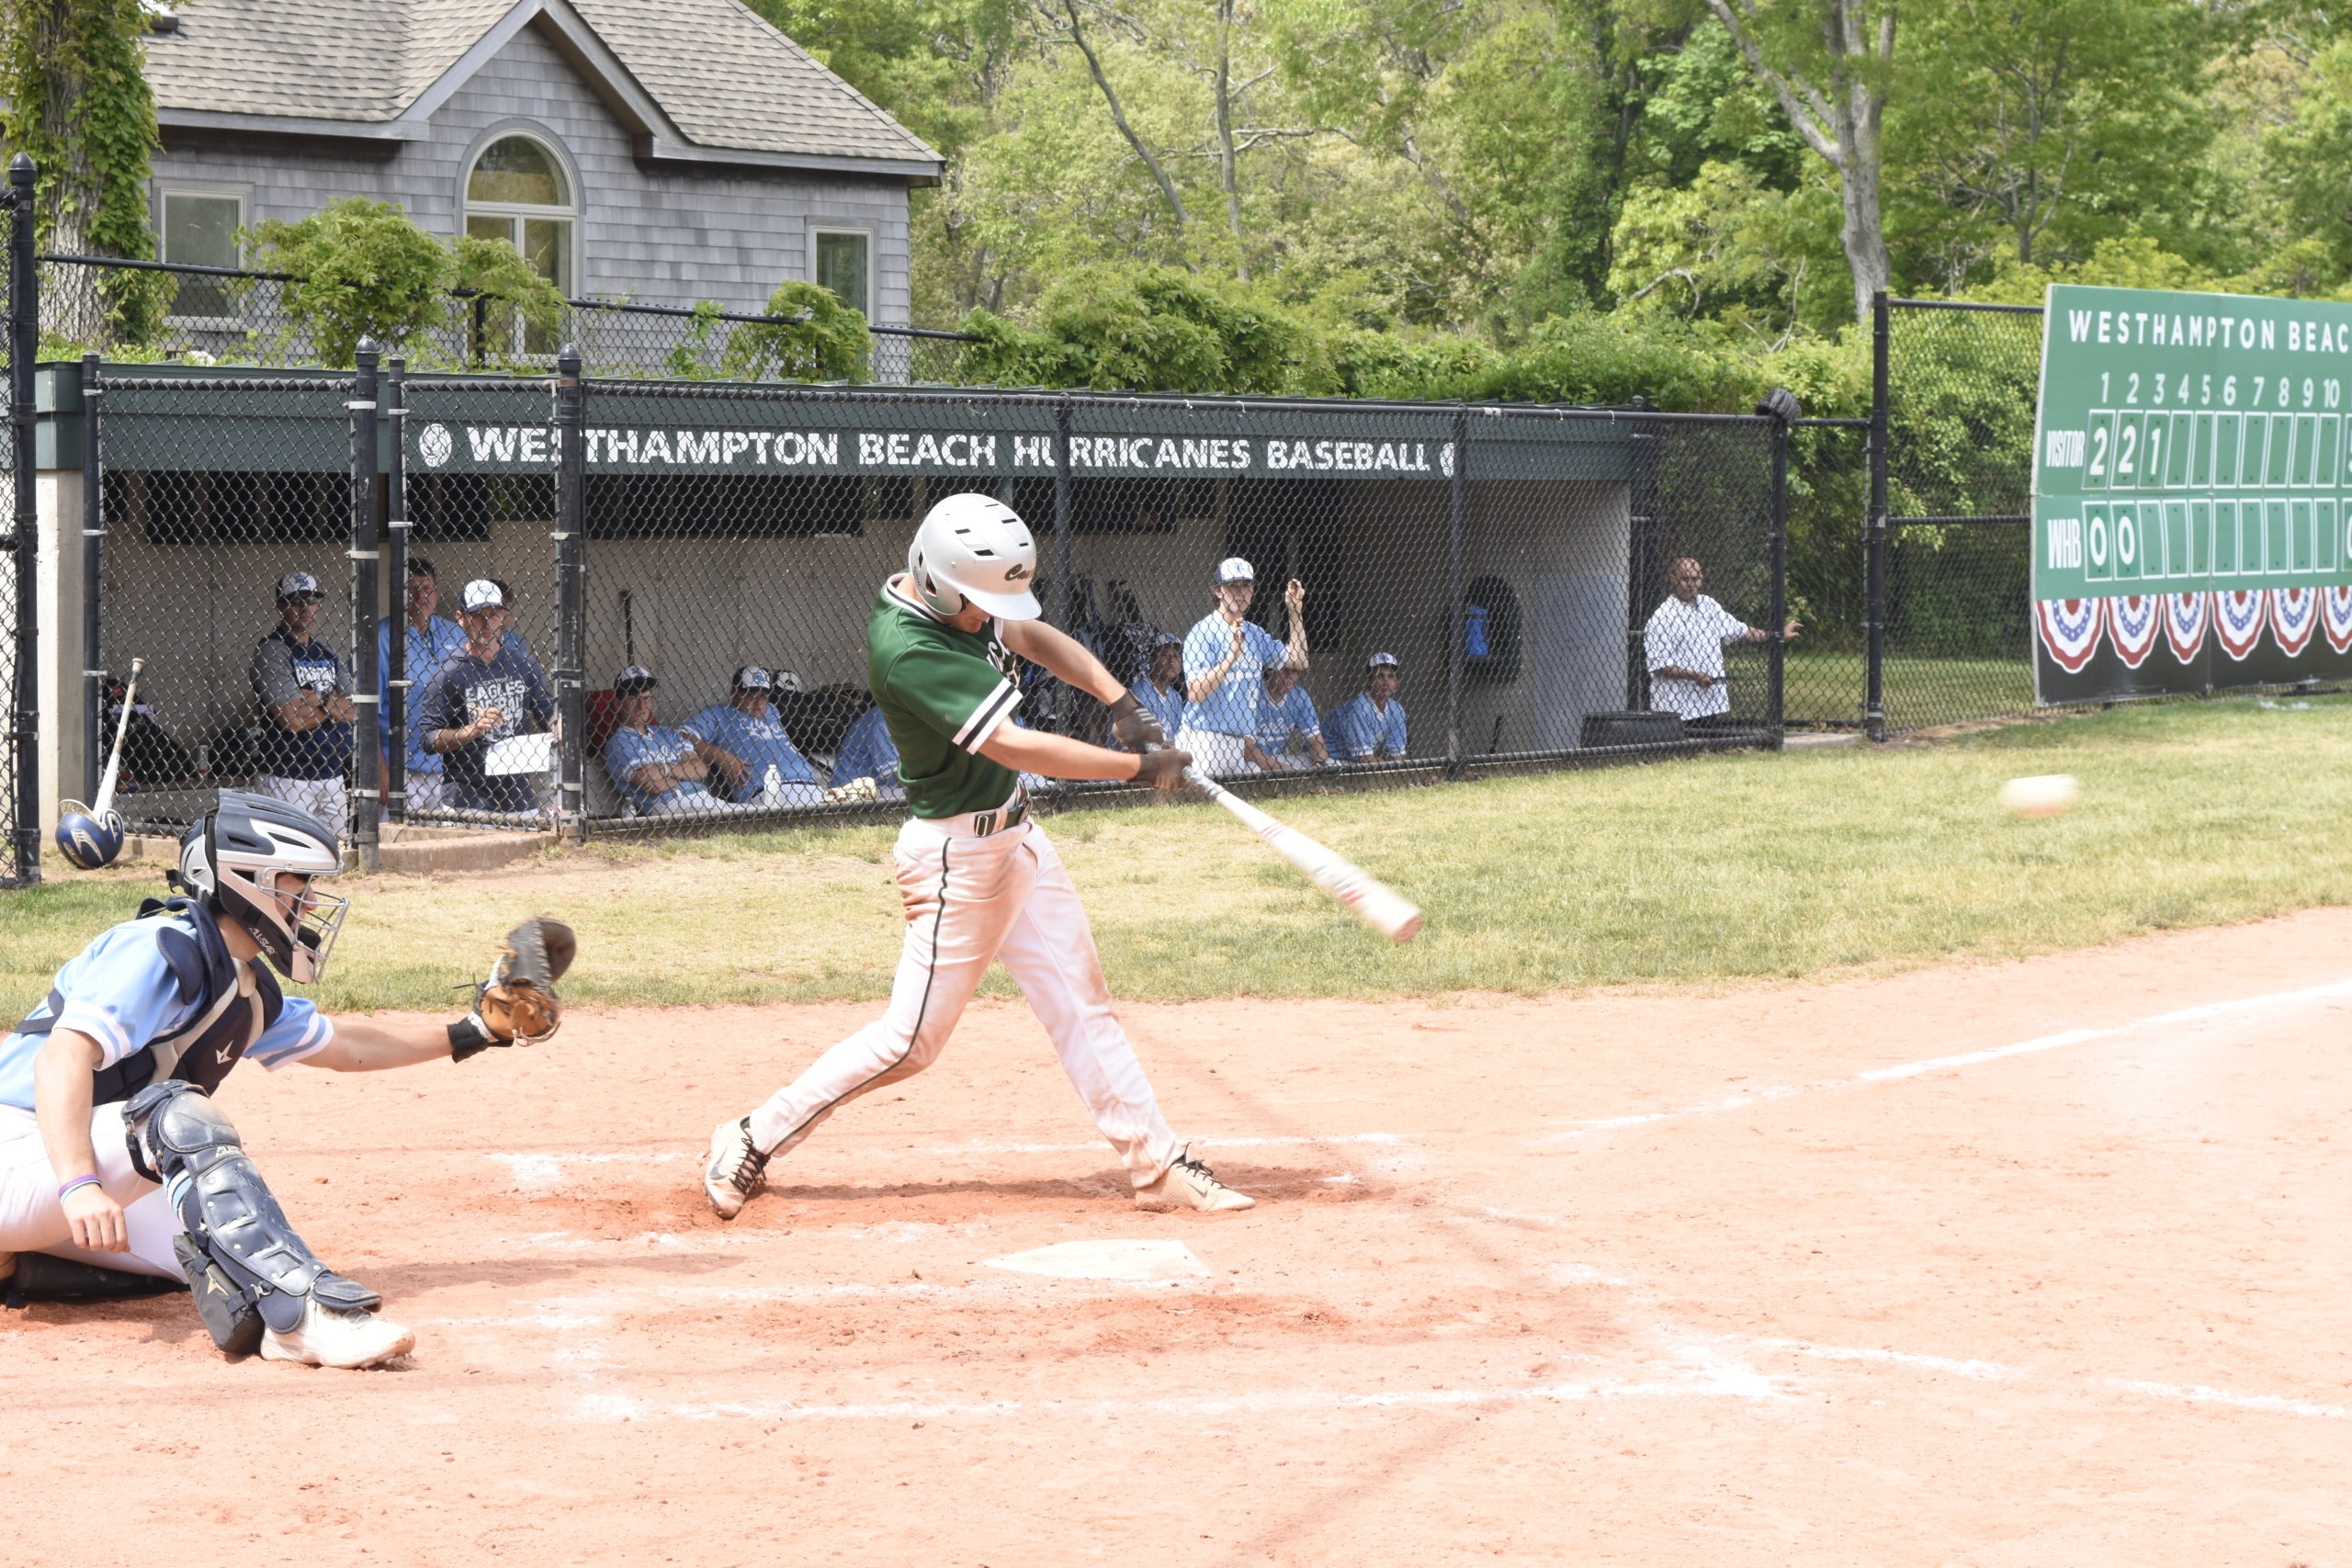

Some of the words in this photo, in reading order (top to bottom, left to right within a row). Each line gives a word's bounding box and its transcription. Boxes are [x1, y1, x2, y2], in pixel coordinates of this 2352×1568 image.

[2068, 309, 2276, 350] WESTHAMPTON
[2288, 320, 2349, 354] BEAC
[2100, 371, 2110, 404] 1
[2125, 372, 2140, 404] 2
[2153, 373, 2166, 405] 3
[2177, 373, 2190, 405] 4
[2200, 374, 2211, 406] 5
[2222, 375, 2237, 407] 6
[2252, 376, 2266, 407] 7
[2278, 377, 2290, 408] 8
[2301, 378, 2314, 408] 9
[2323, 378, 2341, 409] 10
[859, 433, 996, 467] BEACH
[1267, 440, 1430, 471] BASEBALL
[2045, 429, 2086, 468] VISITOR
[2088, 426, 2109, 476] 2
[2117, 424, 2137, 474] 2
[2151, 427, 2161, 475] 1
[2047, 517, 2082, 570] WHB
[2088, 515, 2108, 567] 0
[2117, 514, 2136, 566] 0
[465, 680, 526, 703] EAGLES
